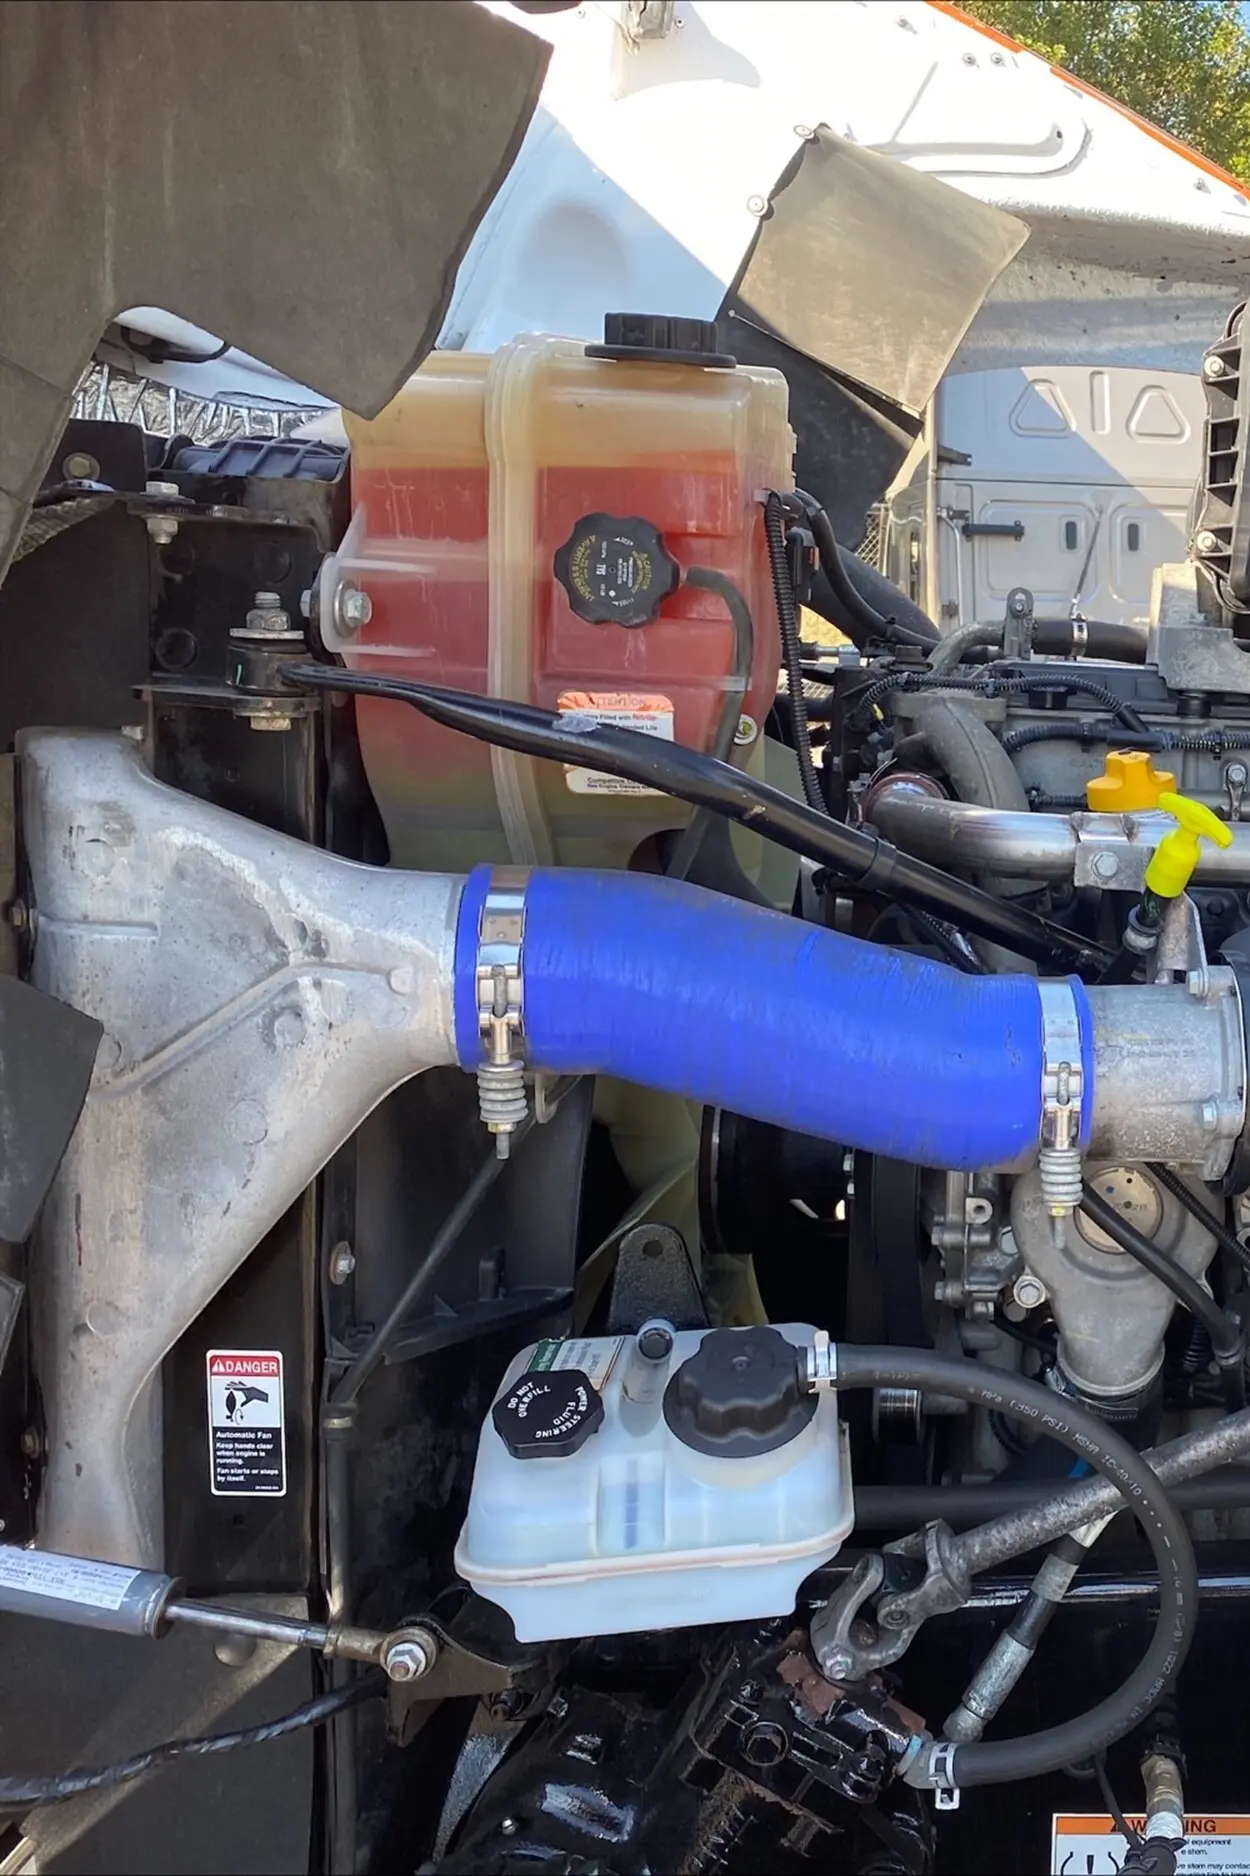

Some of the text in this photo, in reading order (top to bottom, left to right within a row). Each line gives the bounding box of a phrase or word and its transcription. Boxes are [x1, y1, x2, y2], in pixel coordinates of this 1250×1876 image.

[225, 1360, 278, 1374] DANGER
[507, 1381, 534, 1410] DO NOT
[518, 1384, 551, 1418] OVERFILL
[575, 1386, 588, 1412] POWER
[552, 1401, 576, 1426] FLUID
[535, 1414, 581, 1438] STEERING
[216, 1431, 256, 1439] Automatic
[216, 1442, 234, 1450] Keep
[1131, 1819, 1217, 1833] WING
[1191, 1838, 1231, 1847] equipment
[1207, 1863, 1224, 1871] may
